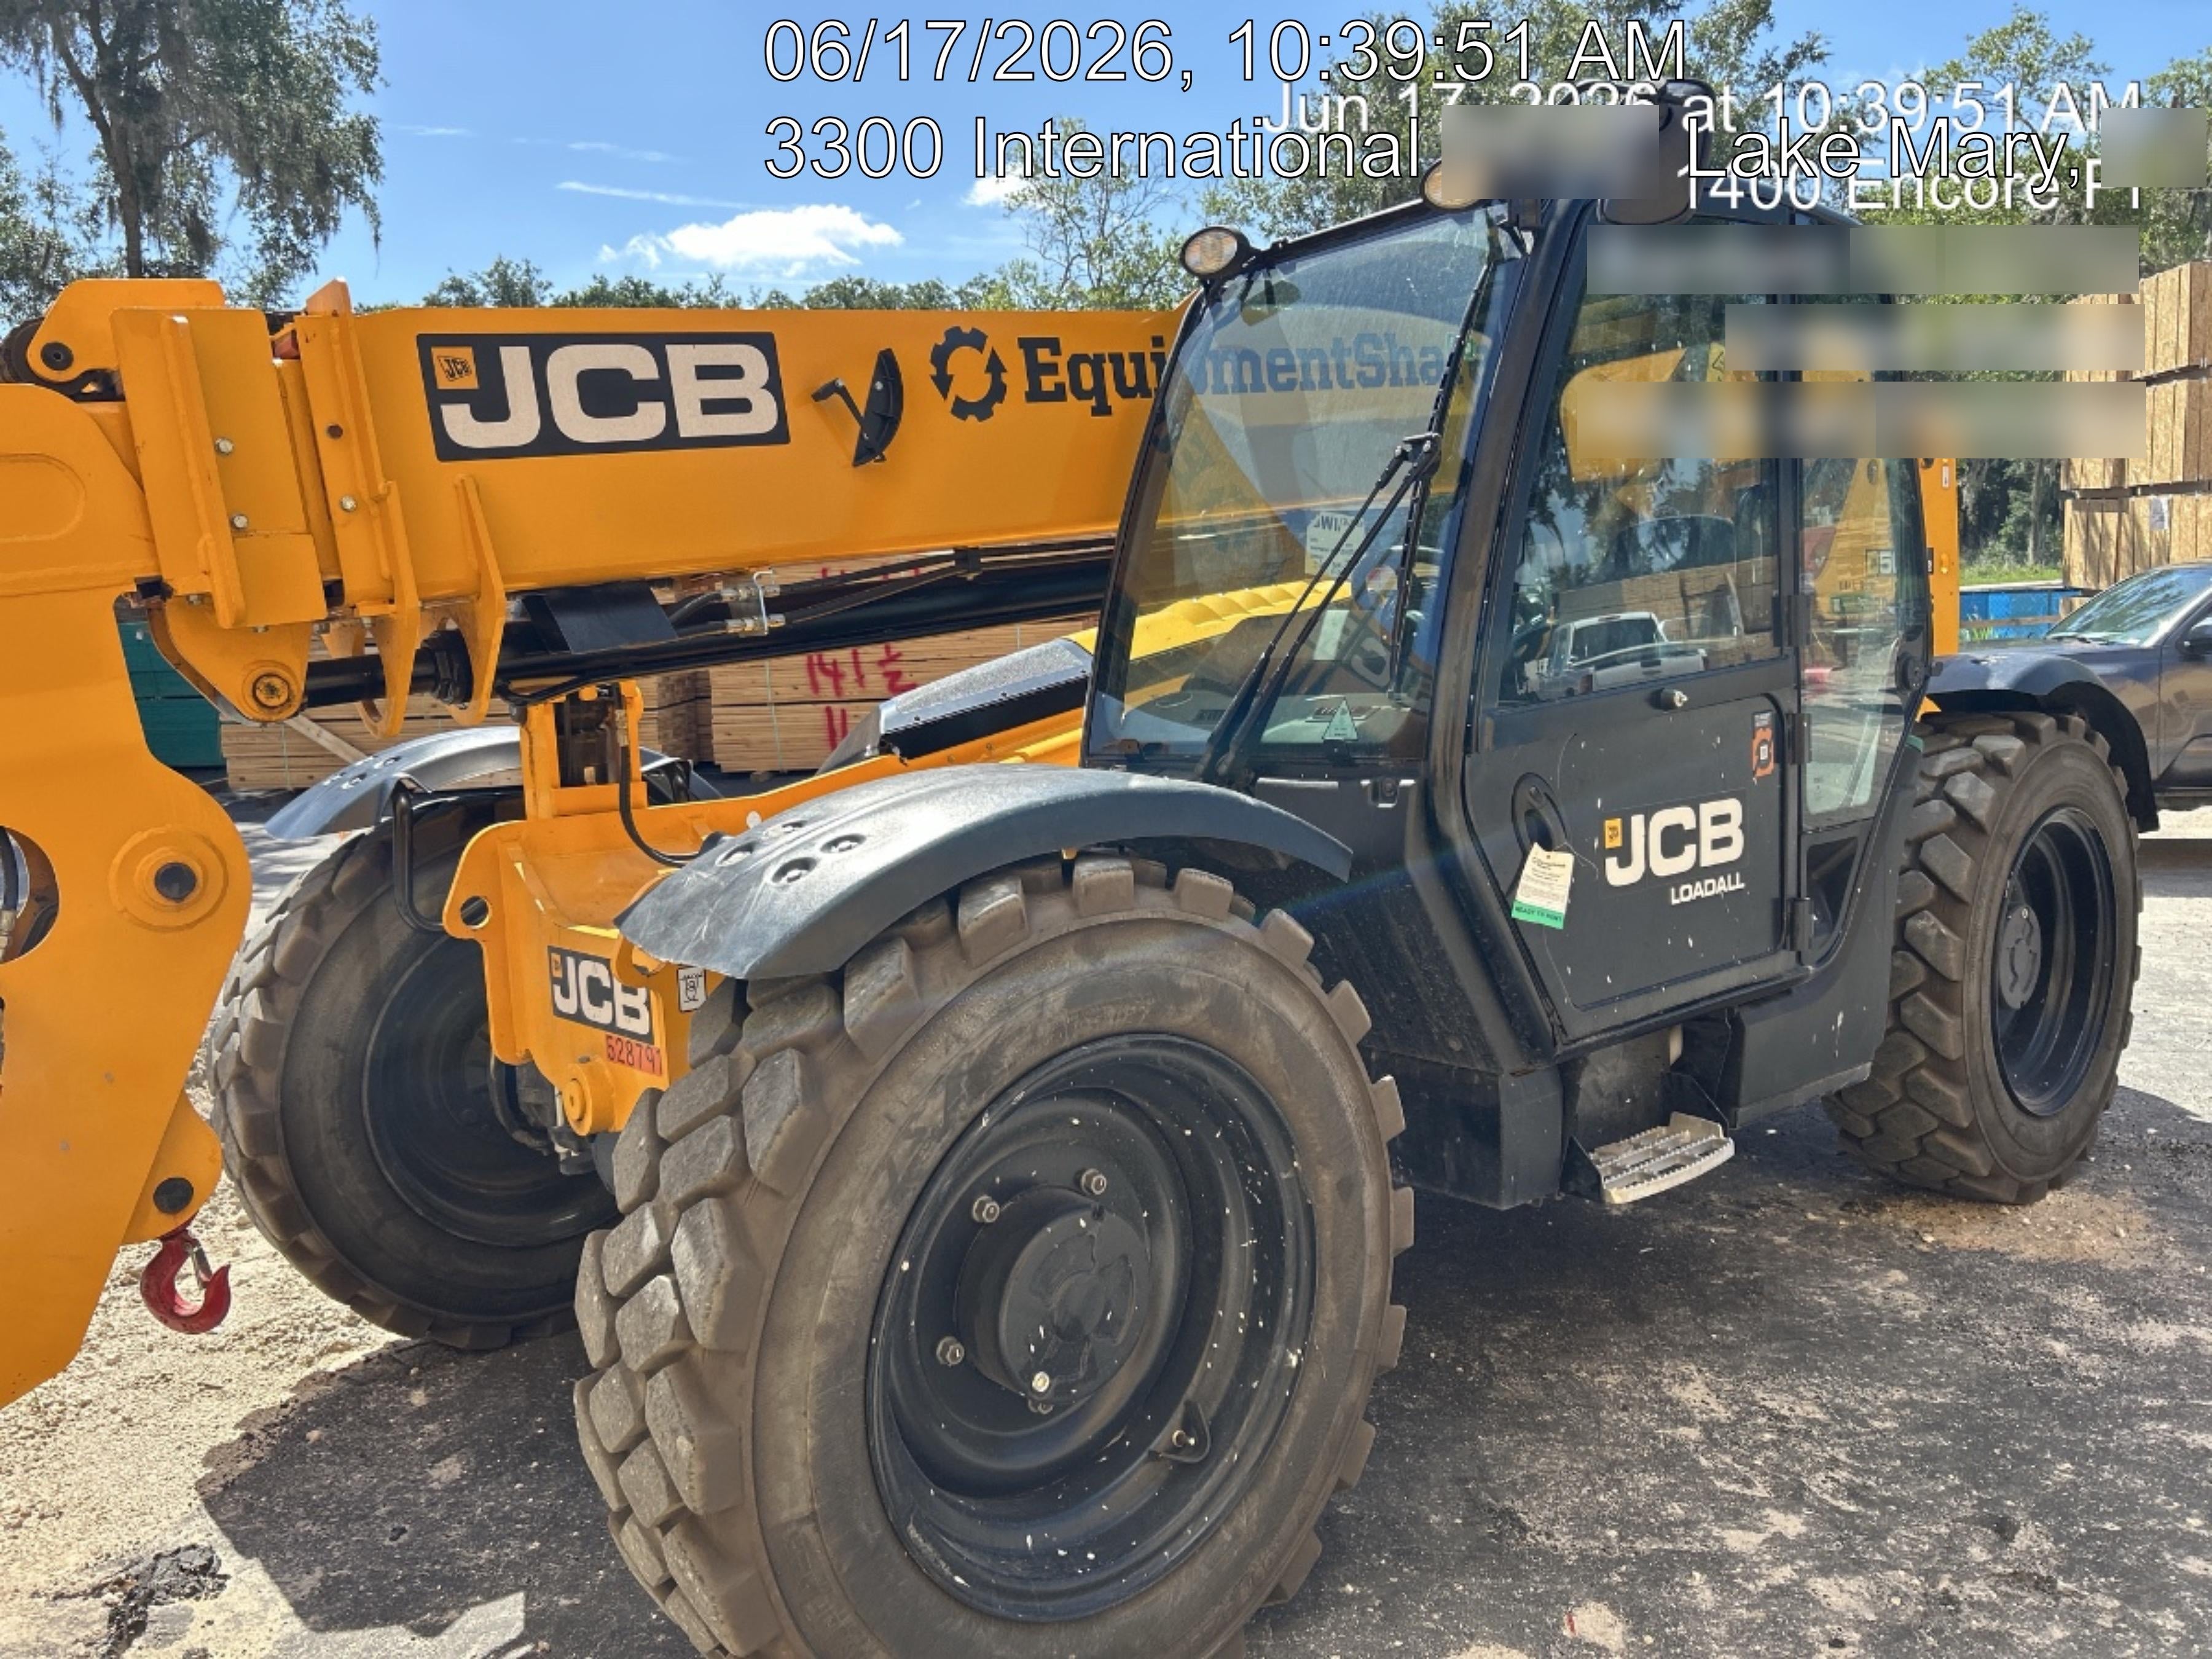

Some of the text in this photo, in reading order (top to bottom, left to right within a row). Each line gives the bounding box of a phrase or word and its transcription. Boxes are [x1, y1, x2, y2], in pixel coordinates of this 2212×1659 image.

[441, 344, 778, 449] JCB
[1605, 797, 1744, 887] JCB
[1671, 871, 1746, 906] LOADALL
[553, 955, 650, 1035] JCB
